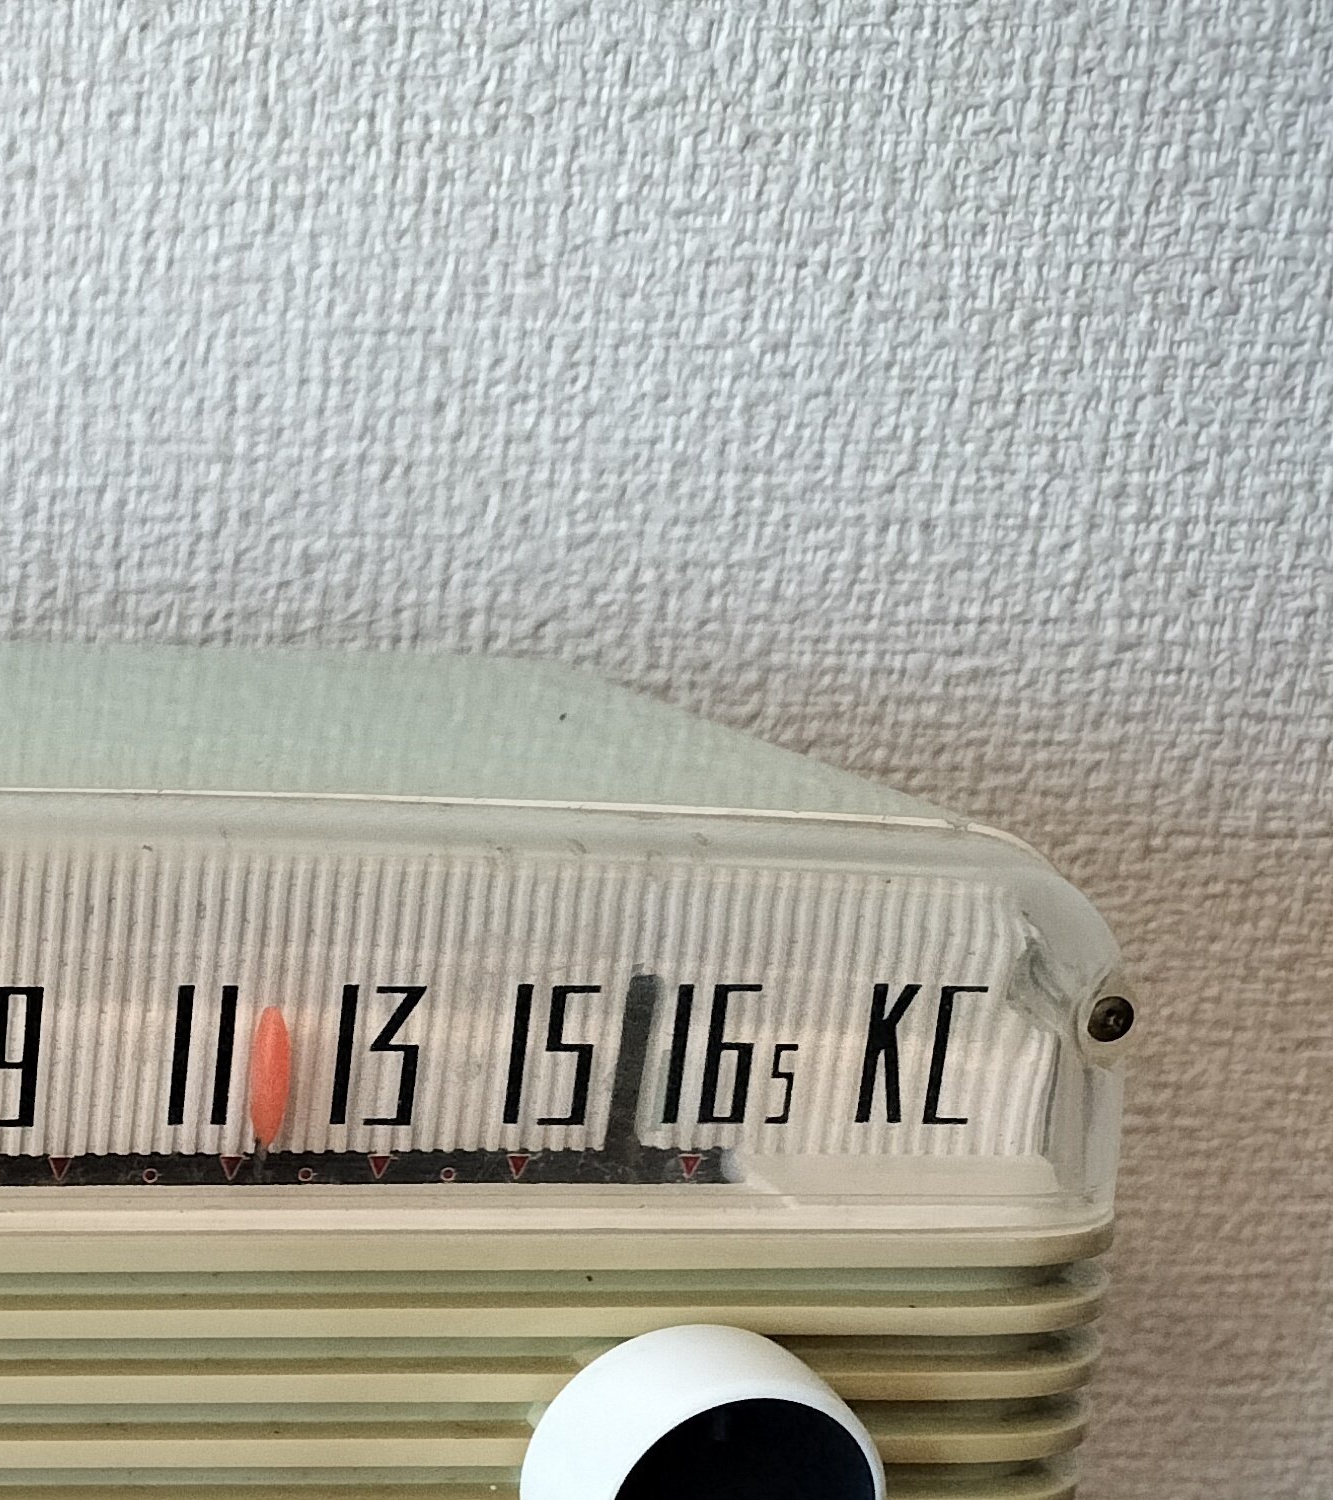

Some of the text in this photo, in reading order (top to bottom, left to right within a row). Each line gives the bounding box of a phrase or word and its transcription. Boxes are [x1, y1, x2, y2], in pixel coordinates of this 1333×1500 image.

[166, 984, 240, 1127] 11
[329, 985, 428, 1127] 13
[501, 983, 602, 1127] 15
[854, 983, 990, 1126] KC
